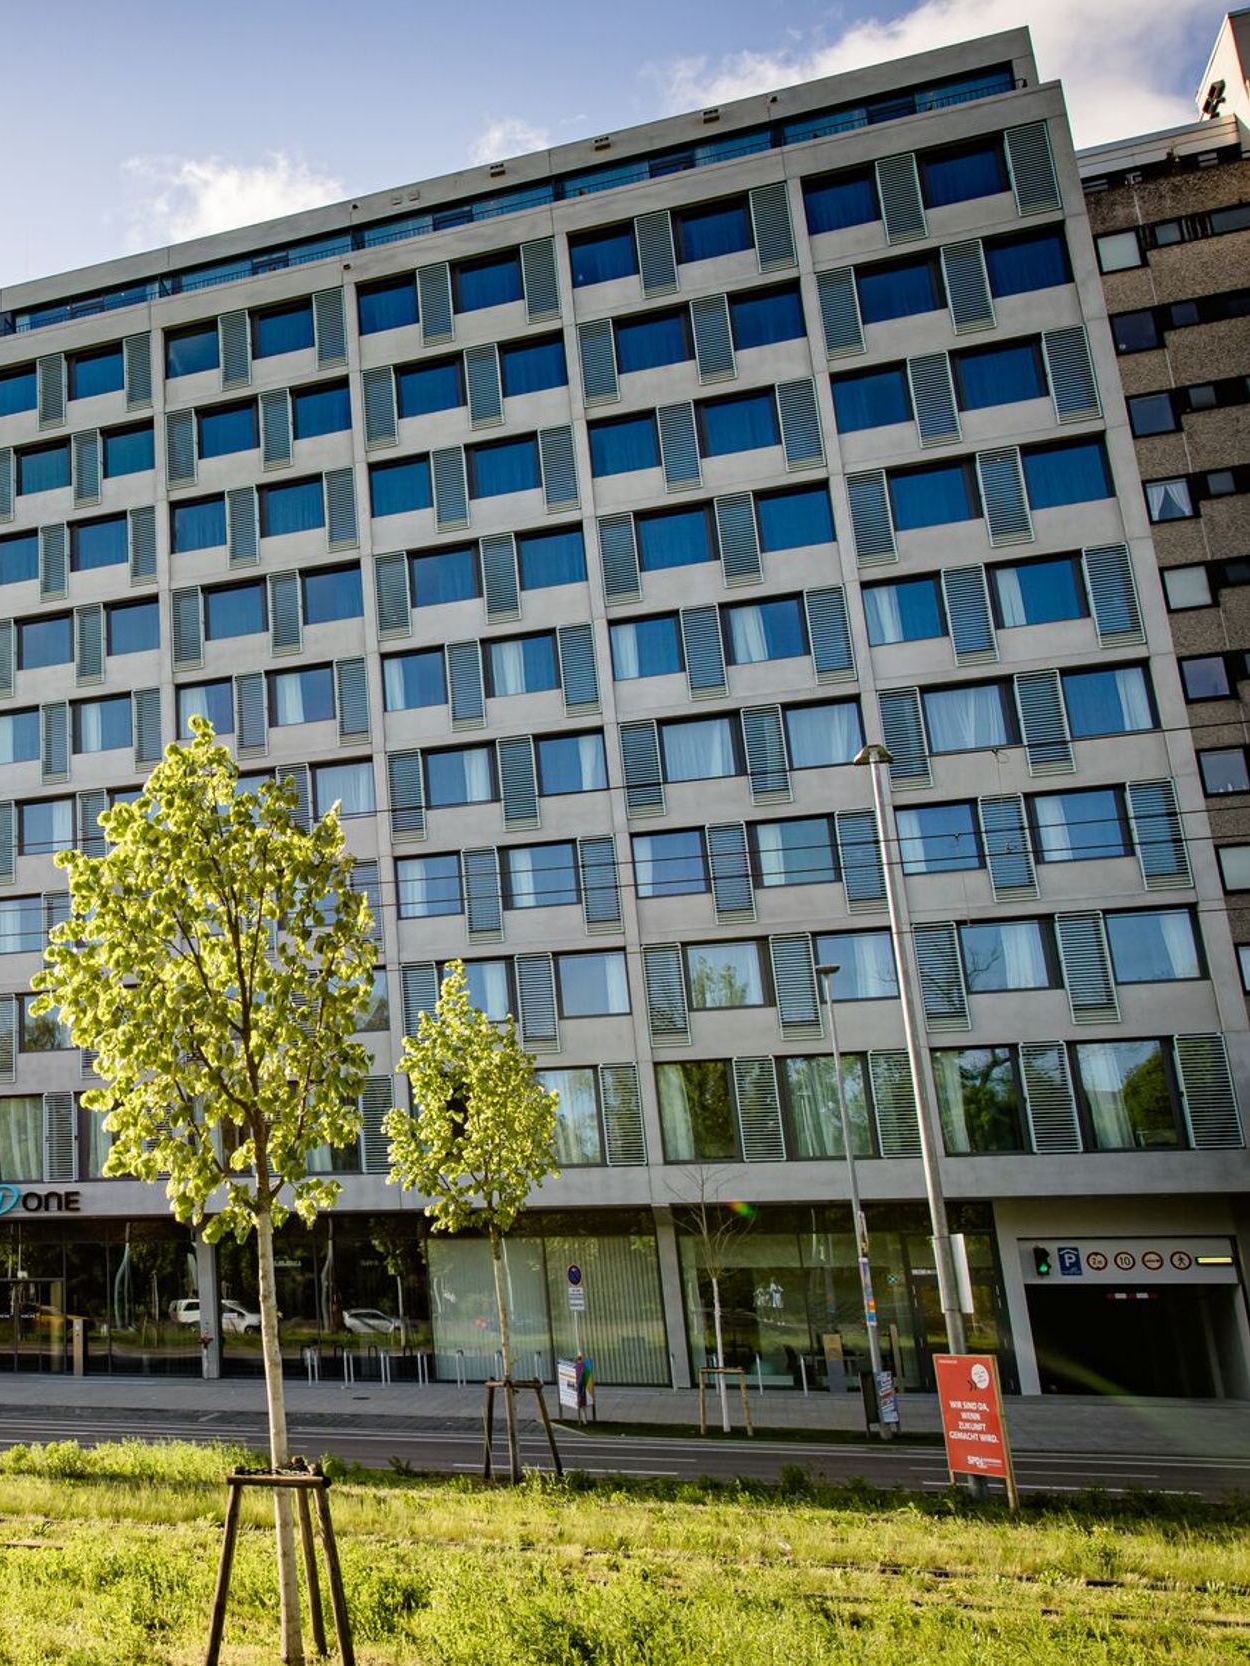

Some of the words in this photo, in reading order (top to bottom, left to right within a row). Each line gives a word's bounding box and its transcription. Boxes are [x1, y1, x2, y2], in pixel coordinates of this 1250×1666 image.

[22, 1191, 81, 1212] ONE
[1065, 1253, 1077, 1267] P
[1118, 1256, 1131, 1266] 10
[949, 1400, 962, 1409] WIR
[962, 1401, 977, 1410] SIND
[960, 1412, 981, 1421] WENN
[958, 1421, 986, 1431] ZUKUNFT
[949, 1431, 979, 1441] GEMACHT
